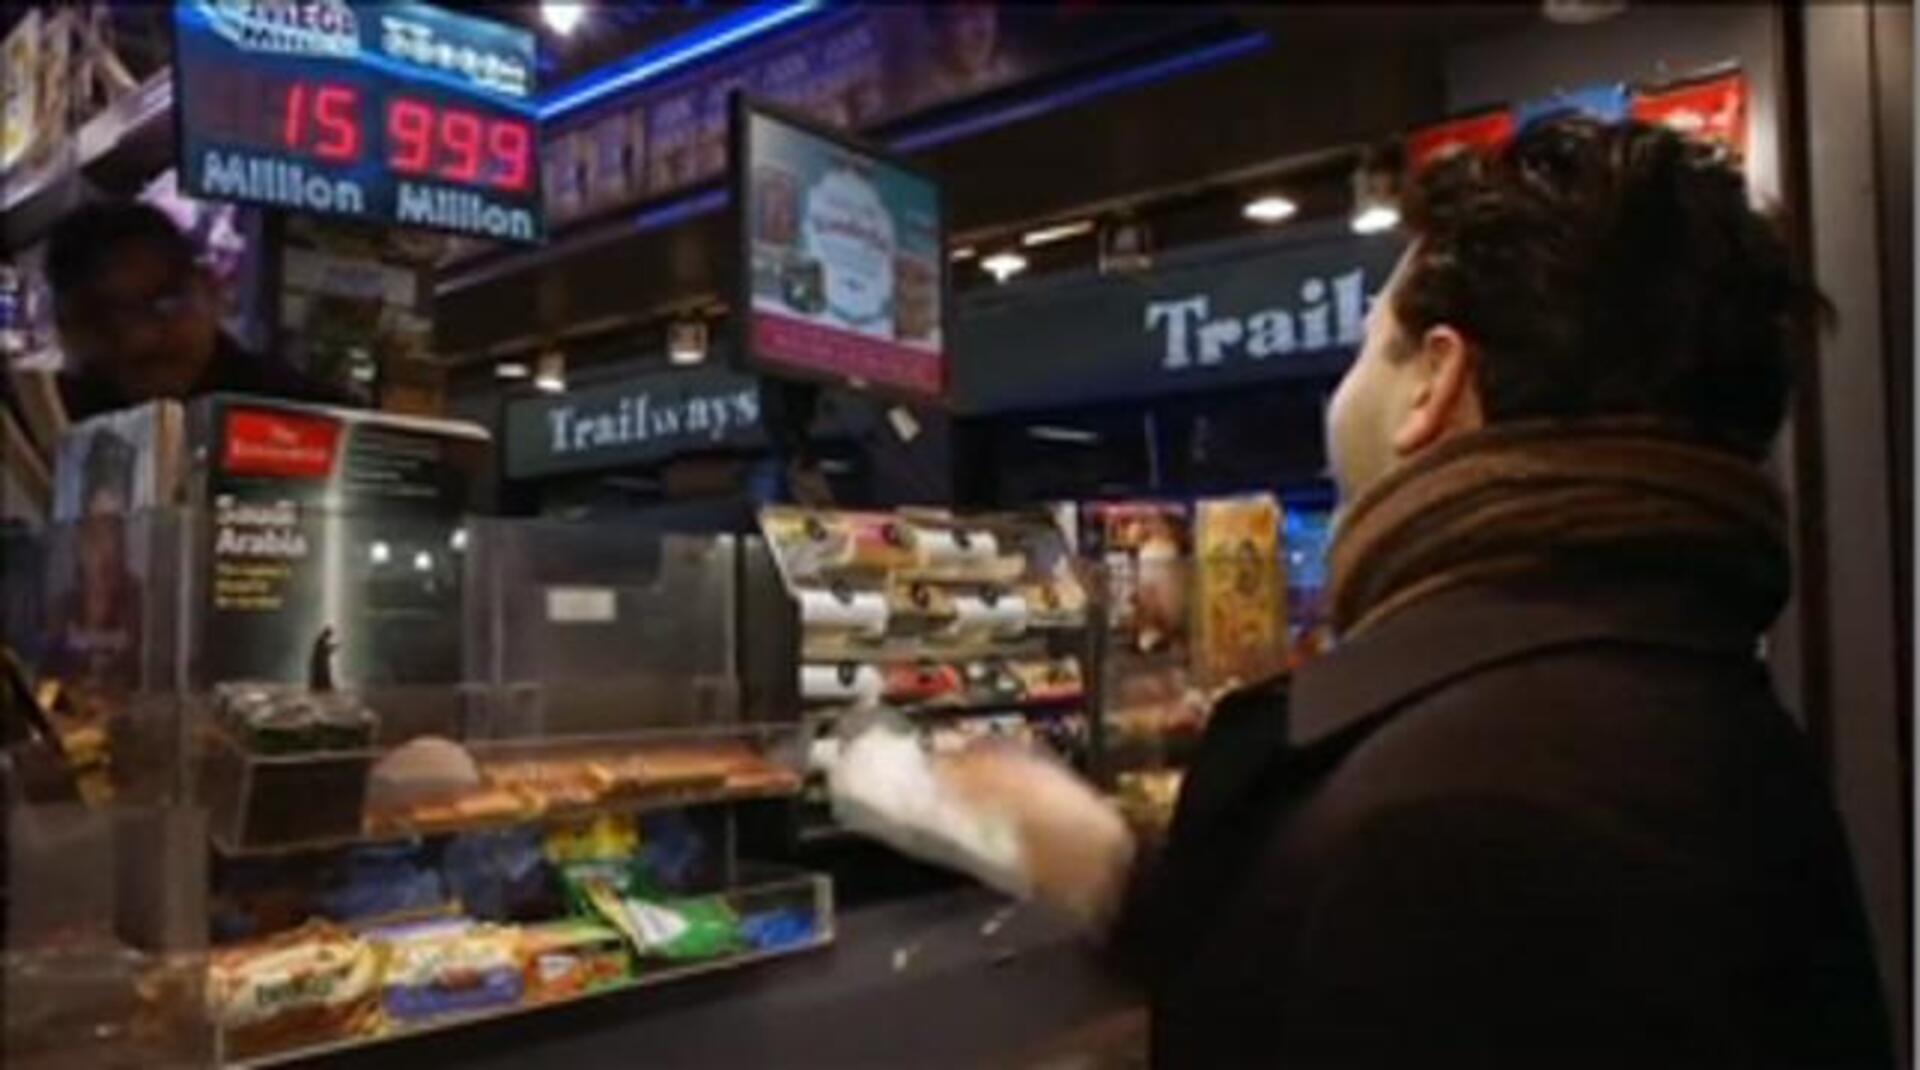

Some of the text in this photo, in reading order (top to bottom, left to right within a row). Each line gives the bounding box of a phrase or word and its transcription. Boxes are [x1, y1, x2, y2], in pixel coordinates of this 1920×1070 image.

[284, 83, 360, 159] 15
[388, 100, 530, 190] 999
[203, 152, 363, 212] Million
[398, 184, 532, 239] Million
[1146, 266, 1377, 370] Trail
[550, 387, 759, 451] Trailways
